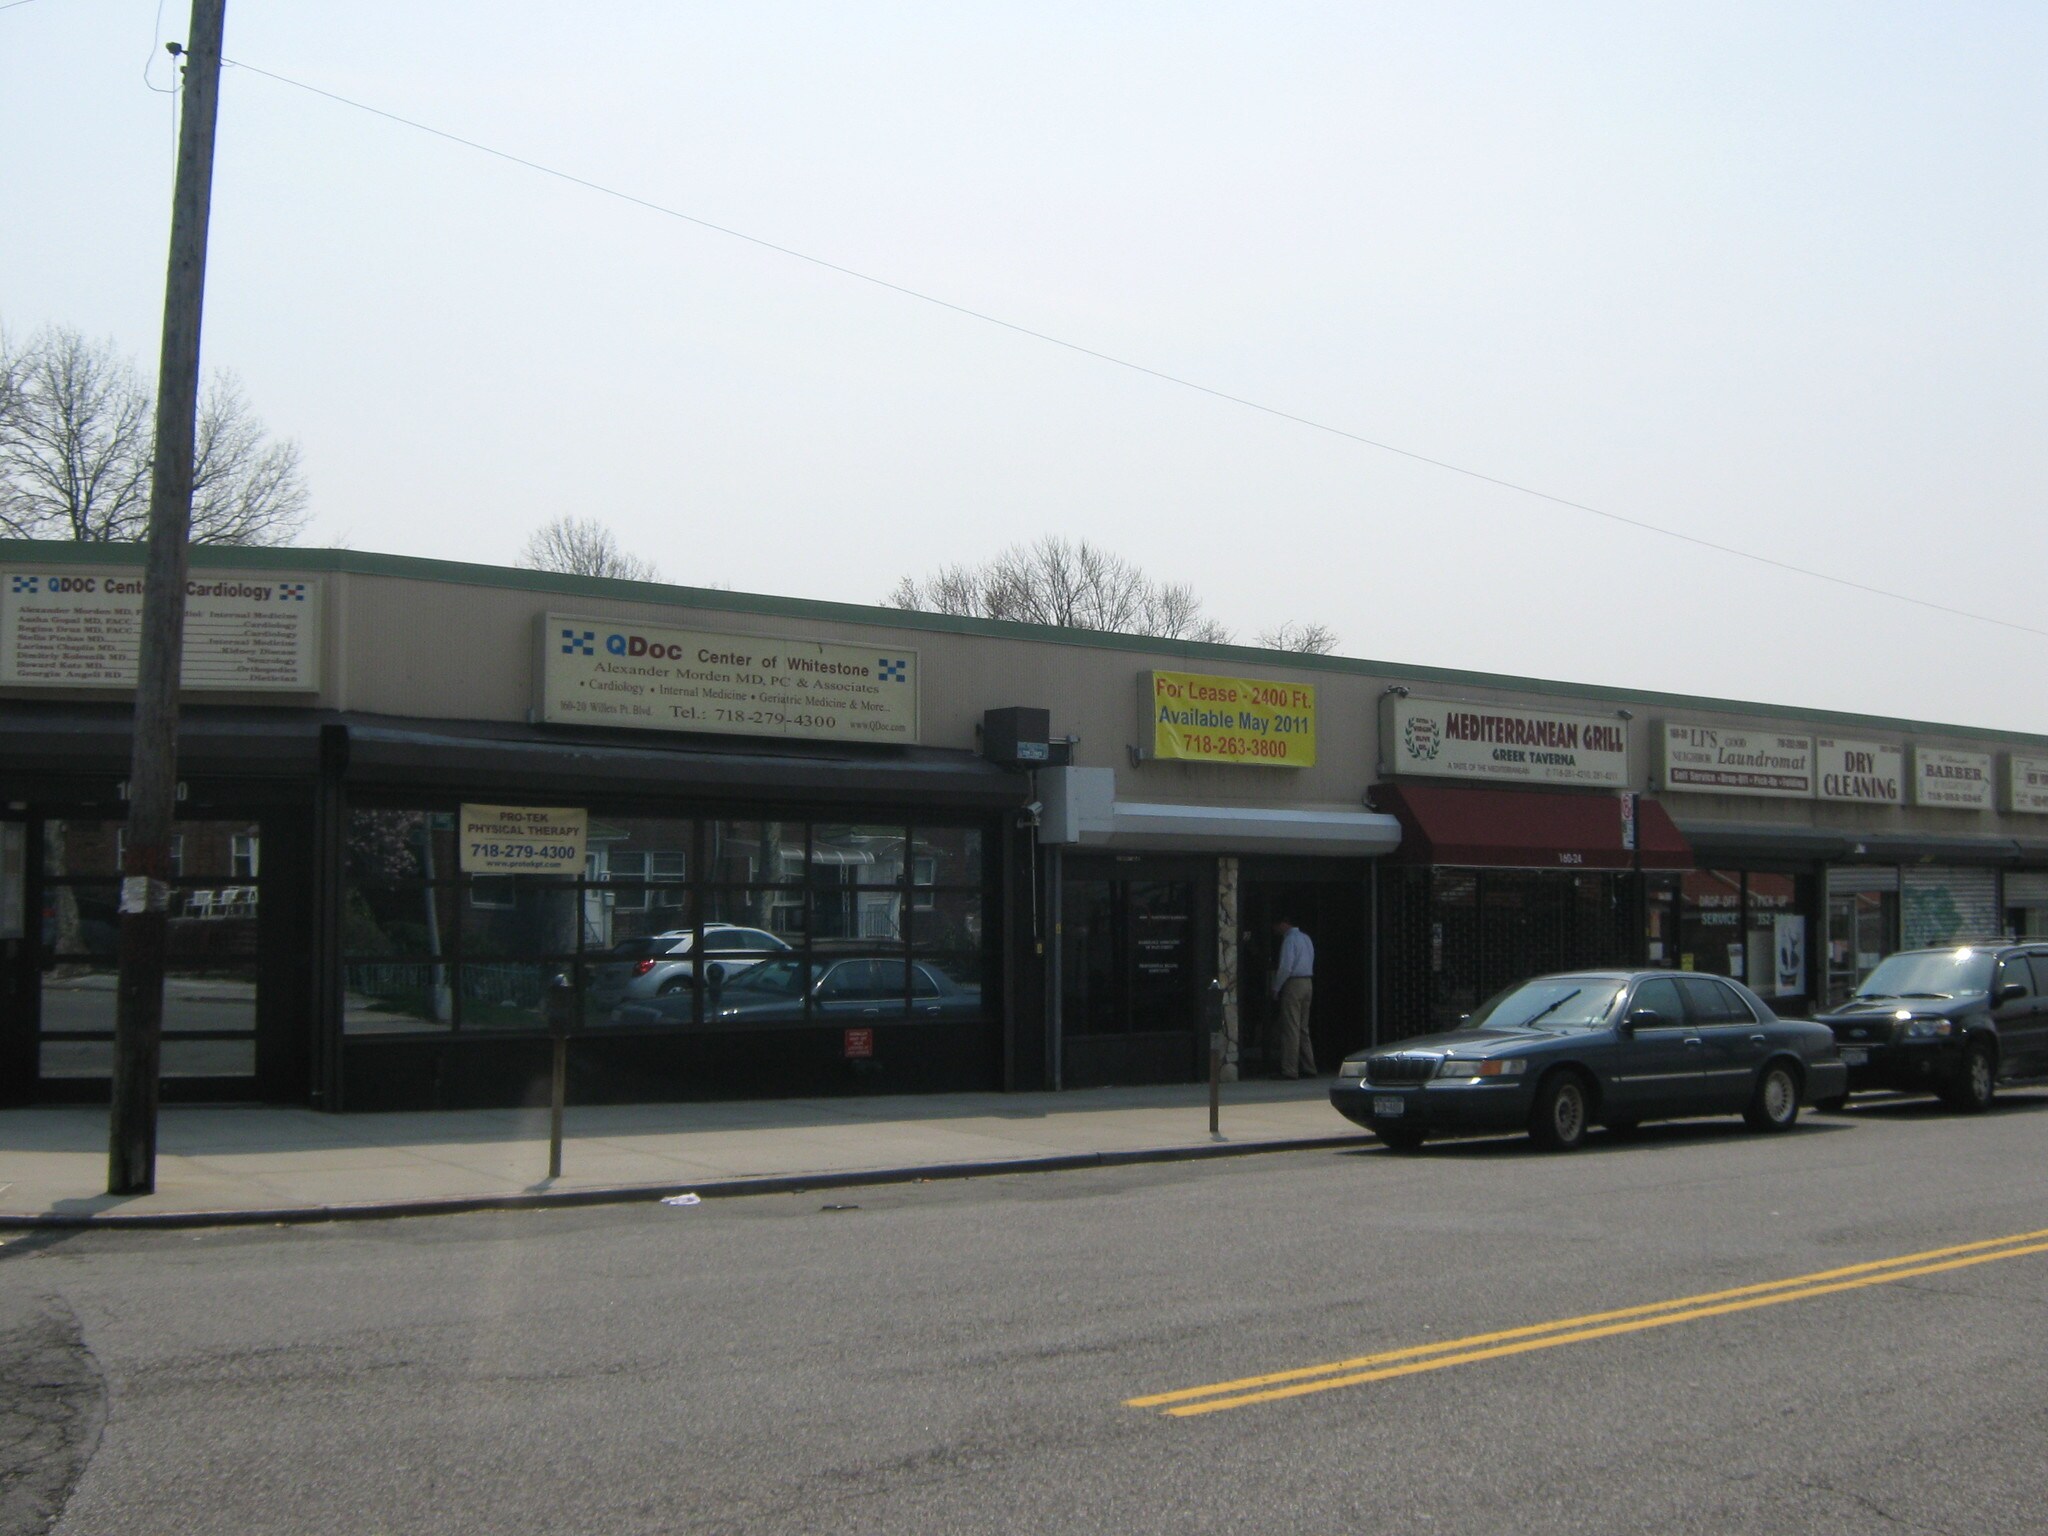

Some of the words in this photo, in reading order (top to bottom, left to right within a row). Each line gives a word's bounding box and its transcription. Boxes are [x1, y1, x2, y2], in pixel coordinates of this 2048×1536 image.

[48, 577, 95, 593] QDOC
[104, 578, 146, 594] Cent
[186, 582, 272, 601] Cardiology
[242, 621, 297, 630] Cardiology
[242, 630, 297, 639] Cardiology
[606, 633, 683, 661] QDoc
[697, 648, 752, 668] Center
[761, 655, 778, 669] of
[787, 657, 870, 677] Whitestone
[594, 661, 671, 679] Alexander
[676, 670, 731, 684] Morden
[736, 672, 767, 687] MD,
[771, 675, 792, 689] PC
[797, 678, 810, 690] &
[812, 681, 881, 695] Associates
[589, 678, 645, 696] Cardiology
[660, 685, 699, 698] Internal
[702, 688, 748, 702] Medicine
[759, 692, 803, 706] Geriatric
[805, 696, 848, 710] Medicine
[849, 701, 858, 710] &
[1156, 678, 1184, 698] For
[1189, 682, 1238, 703] Lease
[1251, 687, 1288, 707] 2400
[1292, 691, 1312, 710] Ft.
[715, 708, 837, 729] 718-279-4300
[1159, 705, 1235, 729] Available
[1239, 711, 1270, 735] May
[1274, 715, 1309, 734] 2011
[1446, 712, 1578, 749] MEDITERRANEAN
[1583, 724, 1624, 752] GRILL
[1690, 728, 1718, 749] LI'S
[1183, 733, 1287, 758] 718-263-3800
[1492, 748, 1526, 763] GREEK
[1529, 752, 1577, 766] TAVERNA
[1717, 747, 1807, 770] Laundromat
[1845, 750, 1875, 774] DRY
[1926, 764, 1982, 781] BARBER
[1824, 773, 1897, 800] CLEANING
[499, 811, 549, 823] PRO-TEK
[467, 824, 525, 835] PHYSICAL
[527, 826, 580, 837] THERAPY
[471, 843, 575, 859] 718-279-4300
[1701, 912, 1737, 925] SERVICE
